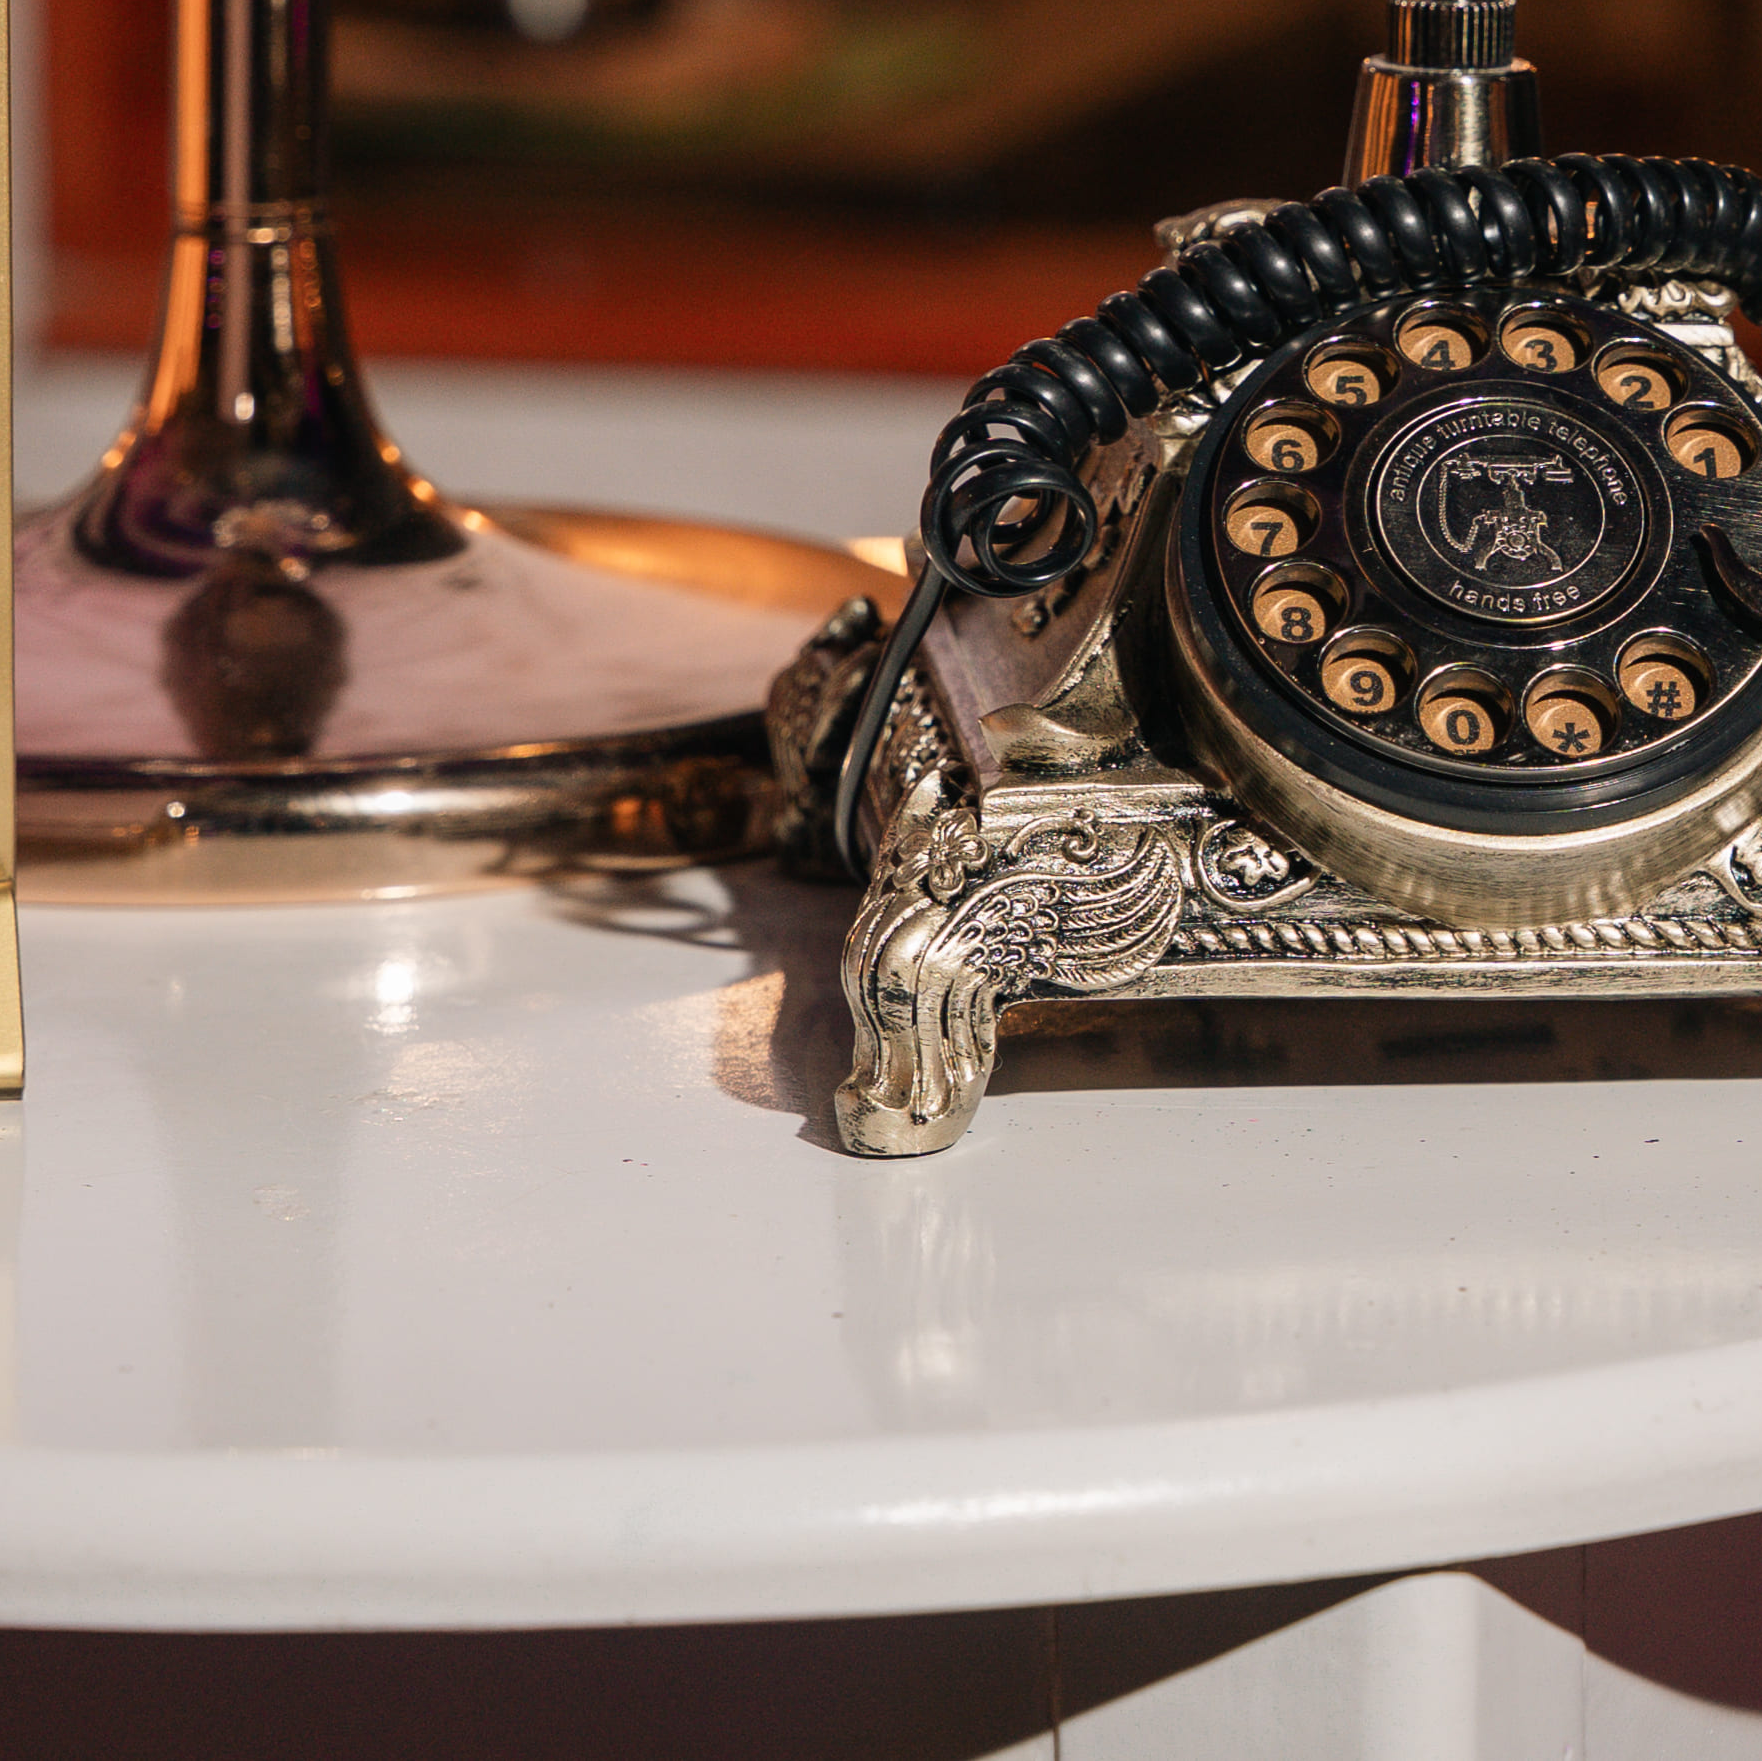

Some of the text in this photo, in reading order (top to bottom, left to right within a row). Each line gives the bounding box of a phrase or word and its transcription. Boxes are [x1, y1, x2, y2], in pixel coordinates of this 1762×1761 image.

[1420, 340, 1456, 370] 4
[1524, 339, 1558, 372] 3
[1335, 375, 1368, 407] 5
[1620, 375, 1654, 409] 2
[1271, 439, 1304, 472] 6
[1388, 409, 1629, 507] antique turntable telephone
[1693, 447, 1717, 479] 1
[1251, 522, 1283, 556] 7
[1448, 580, 1581, 613] hands free
[1281, 606, 1314, 642] 8
[1350, 671, 1384, 707] 9
[1446, 709, 1481, 745] 0
